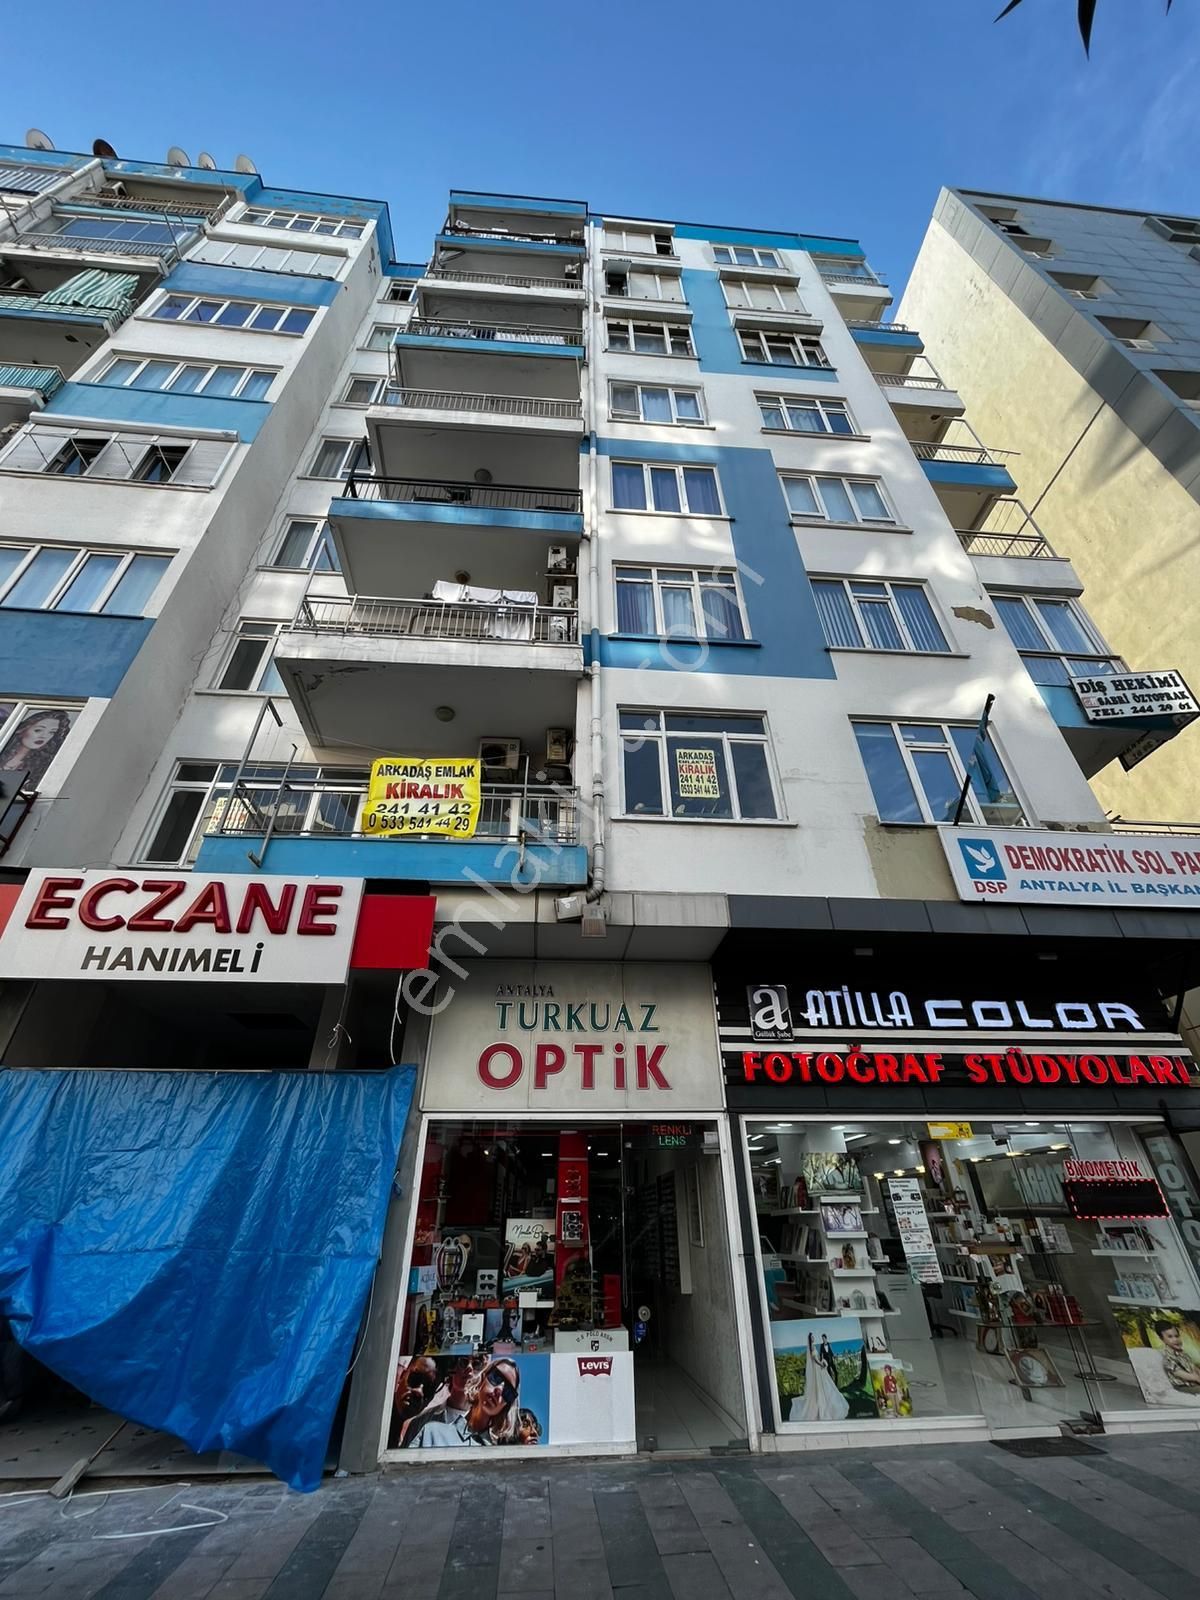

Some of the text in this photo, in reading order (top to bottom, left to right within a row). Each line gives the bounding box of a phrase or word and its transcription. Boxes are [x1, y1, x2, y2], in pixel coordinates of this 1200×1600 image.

[1077, 673, 1180, 695] DİŞ HEKİMİ
[1132, 691, 1190, 703] ÖZTOPRAK
[1130, 705, 1154, 714] 244
[1179, 702, 1192, 710] 61
[377, 764, 475, 781] ARKADAŞ EMLAK
[680, 775, 716, 784] 241 41 42
[385, 779, 464, 800] KİRALIK
[375, 803, 472, 815] 241 41 42
[369, 813, 470, 831] 0 533 541 44 29
[1004, 843, 1135, 874] DEMOKRATİK
[1132, 850, 1176, 874] SOL
[972, 880, 1008, 894] DSP
[1020, 879, 1104, 893] ANTALYA
[1107, 880, 1127, 893] İL
[25, 877, 343, 936] ECZANE
[81, 942, 264, 973] HANIMELİ
[496, 984, 555, 997] ANTALYA
[800, 985, 1145, 1030] ATİLLA COLOR
[495, 1001, 660, 1032] TURKUAZ
[742, 1043, 1192, 1084] FOTOĞRAF STÜDYOLARI
[659, 1135, 686, 1146] LENS
